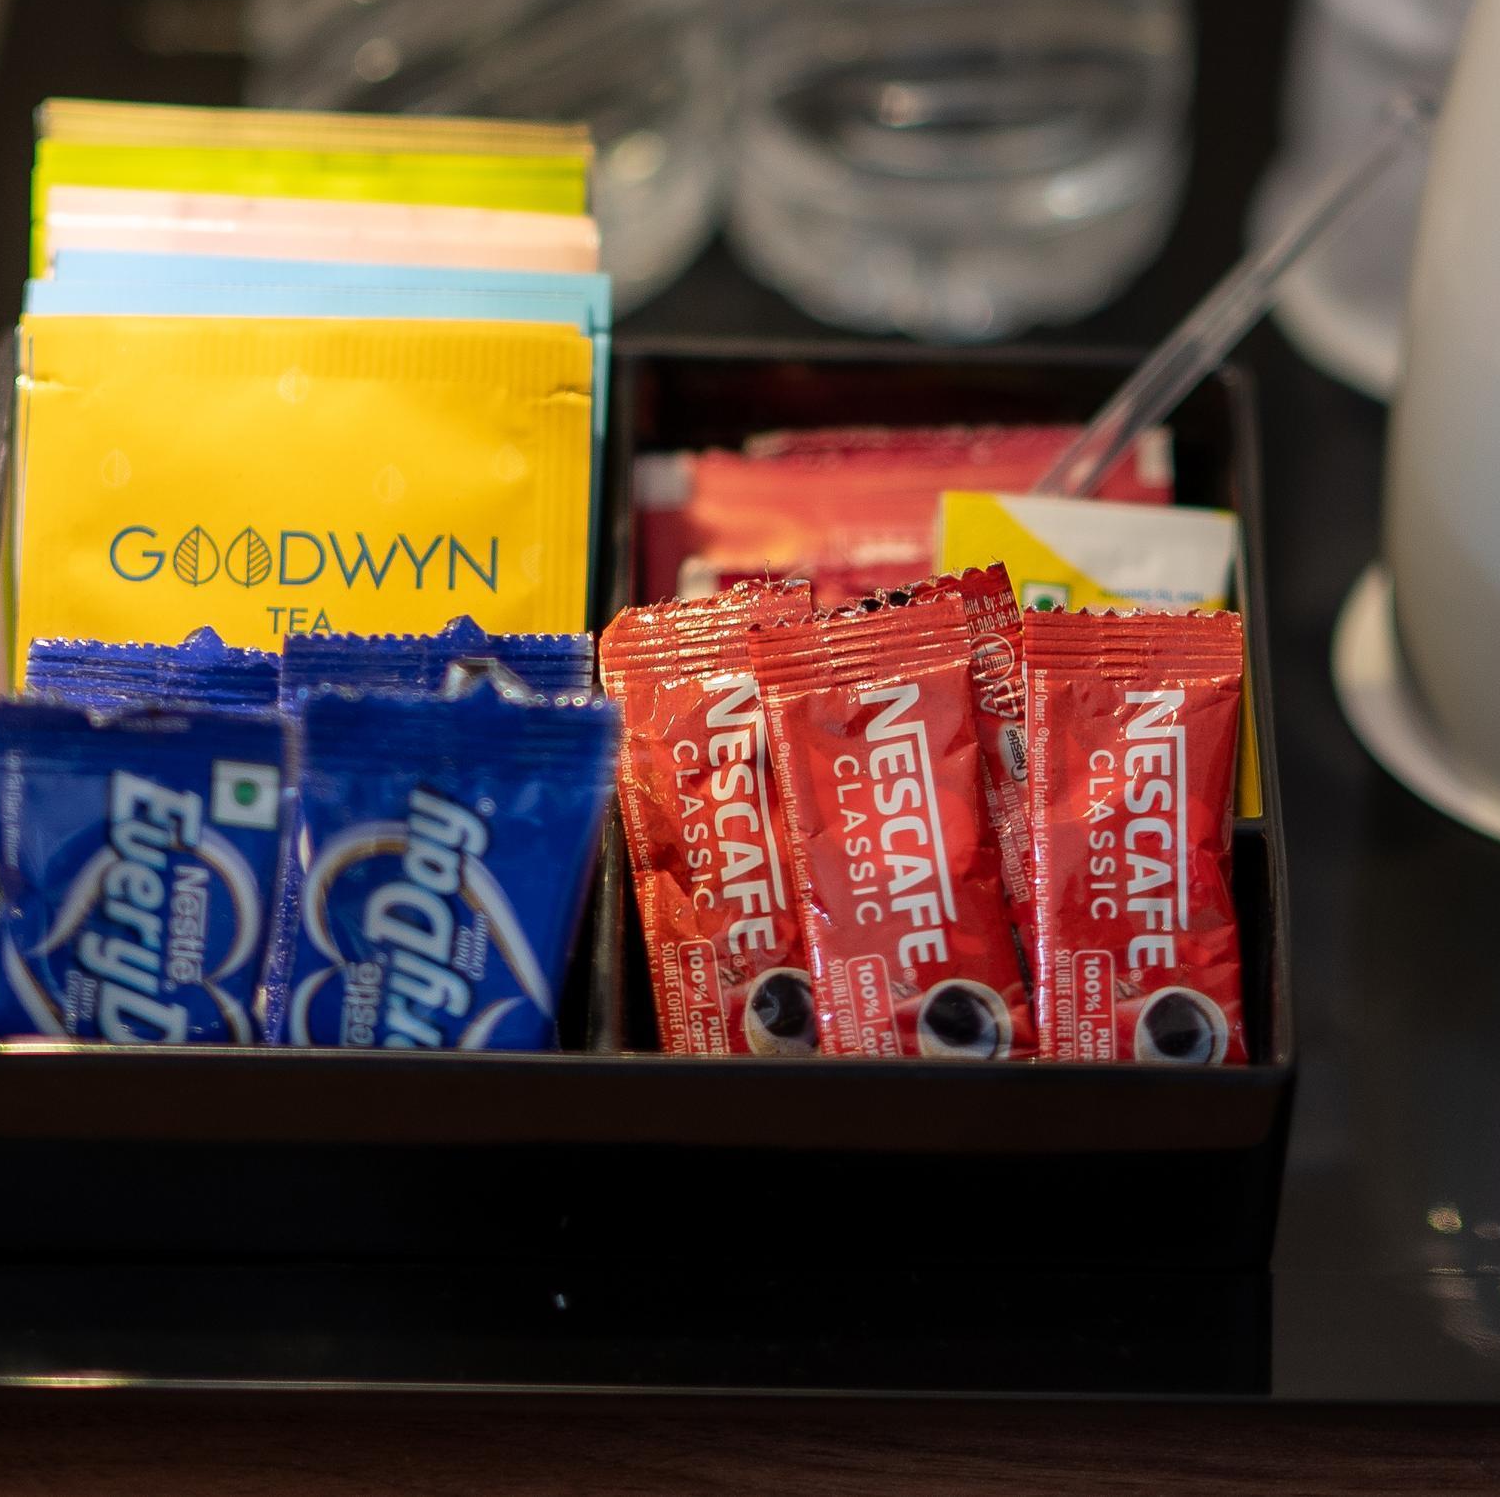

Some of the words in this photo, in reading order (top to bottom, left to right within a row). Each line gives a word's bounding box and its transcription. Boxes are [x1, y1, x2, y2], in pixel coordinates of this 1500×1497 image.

[109, 524, 499, 593] GOODWYN
[266, 606, 333, 635] TEA
[1034, 668, 1048, 693] Brand
[1034, 694, 1048, 725] Owner:
[673, 739, 716, 911] CLASSIC
[1034, 784, 1048, 830] Trademark
[833, 755, 883, 925] CLASSIC
[1089, 749, 1118, 919] CLASSIC
[453, 925, 475, 970] Dairy
[661, 941, 680, 990] SOLUBLE
[687, 947, 710, 1003] 100%
[828, 959, 849, 1006] SOLUBLE
[856, 962, 881, 1017] 100%
[1055, 949, 1073, 996] SOLUBLE
[1083, 957, 1101, 1012] 100%
[666, 991, 685, 1033] COFFEE
[836, 1008, 856, 1049] COFFEE
[1056, 999, 1073, 1039] COFFEE
